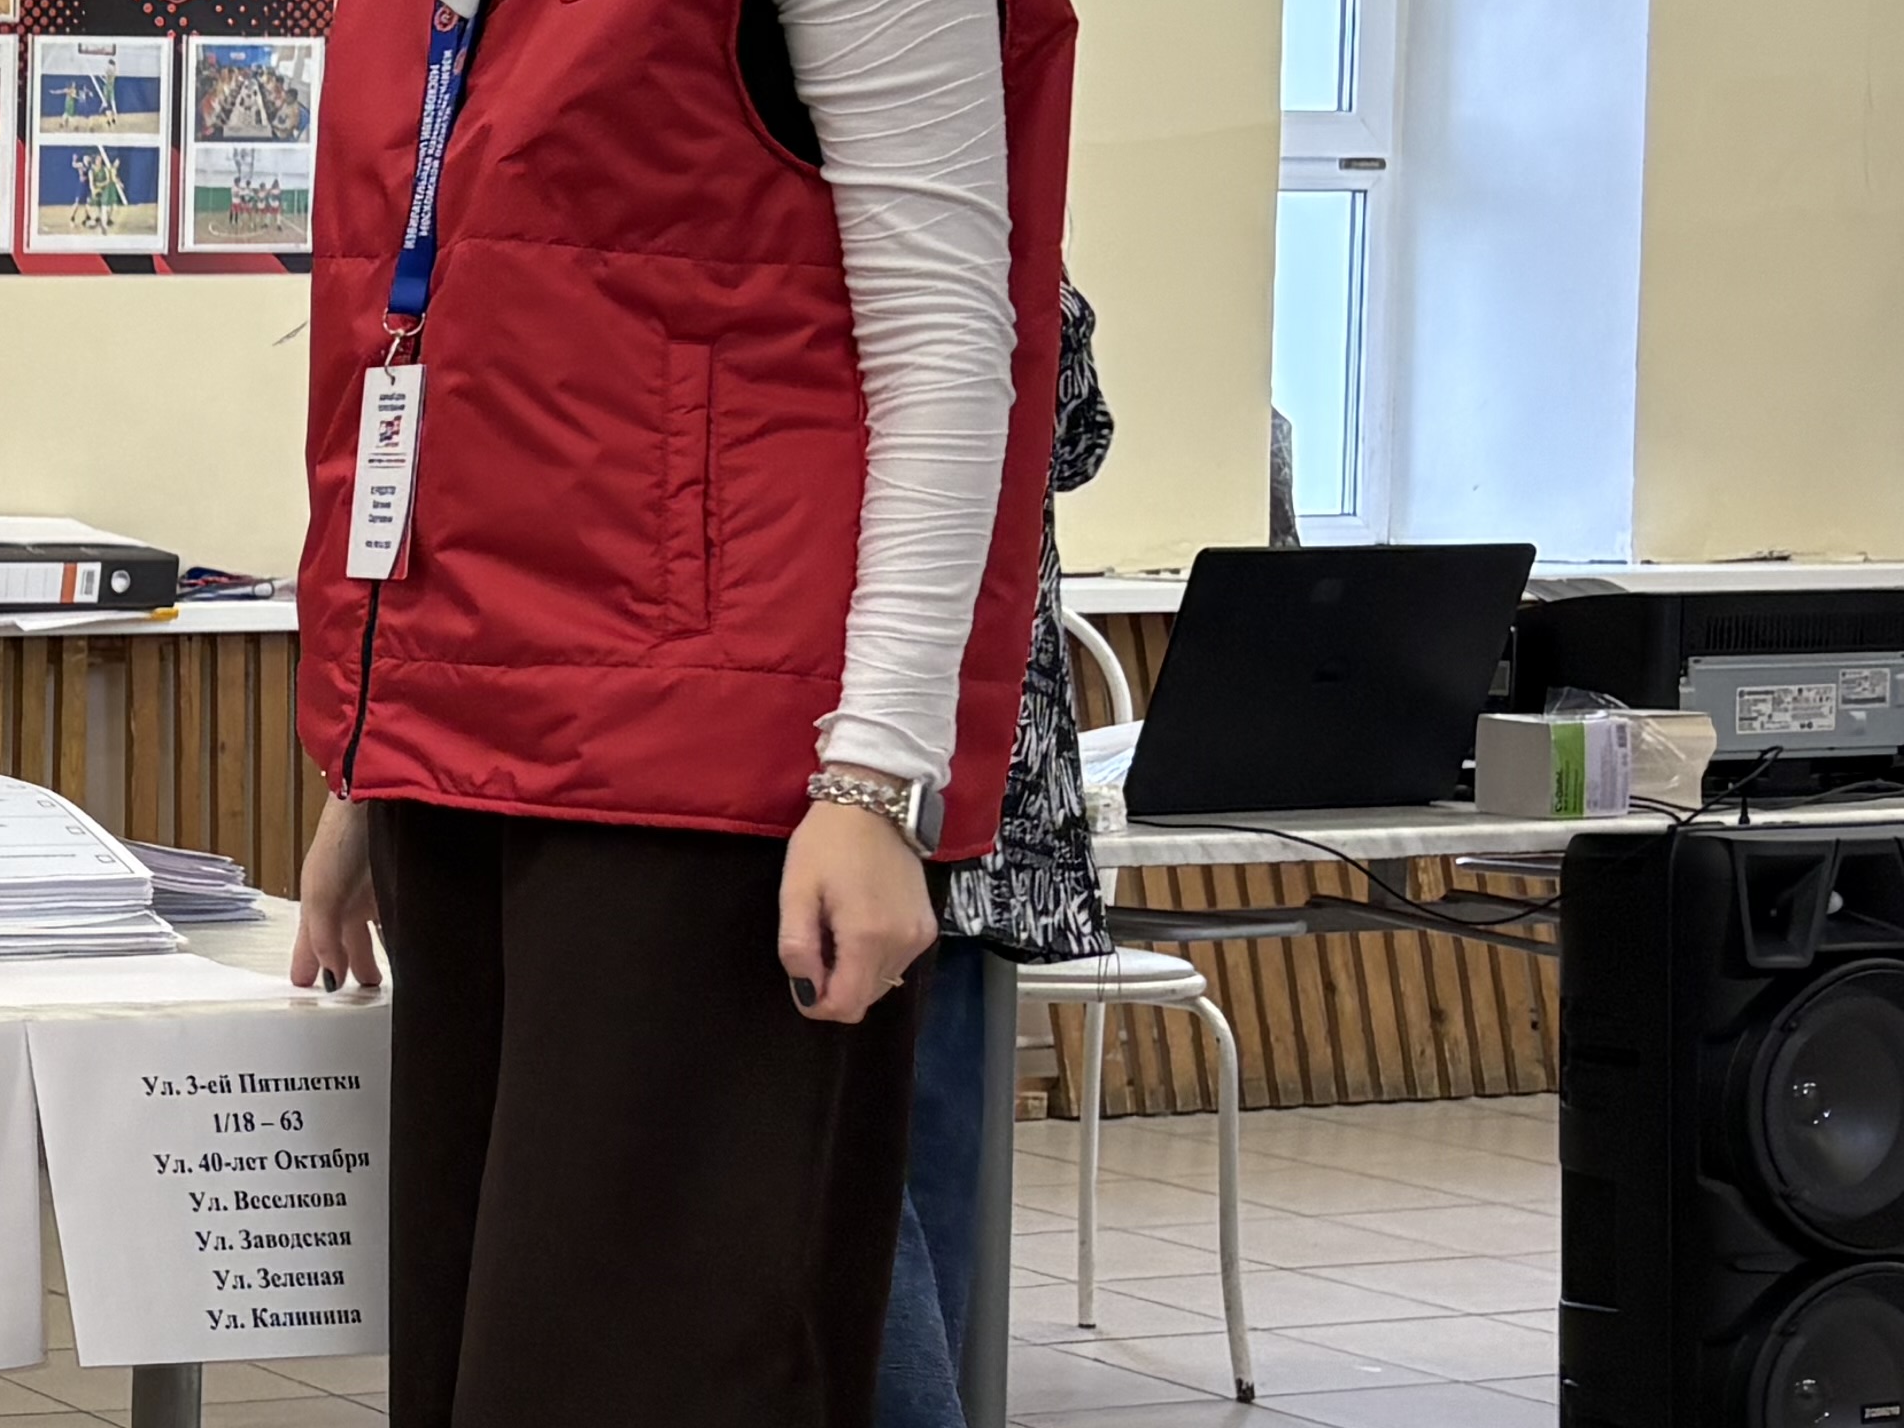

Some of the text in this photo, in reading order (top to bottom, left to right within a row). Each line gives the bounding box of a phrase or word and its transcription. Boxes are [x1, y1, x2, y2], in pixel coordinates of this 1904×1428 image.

[141, 1073, 361, 1097] Ул. 3-ей Пятилетки
[213, 1111, 256, 1133] 1/18
[279, 1110, 304, 1131] 63
[153, 1147, 370, 1175] Ул. 40-лет Октября
[188, 1190, 348, 1213] Ул. Веселкова
[194, 1229, 353, 1252] Ул. Заводская
[212, 1267, 345, 1291] Ул. Зеленая
[205, 1307, 363, 1331] Ул. Калинина
